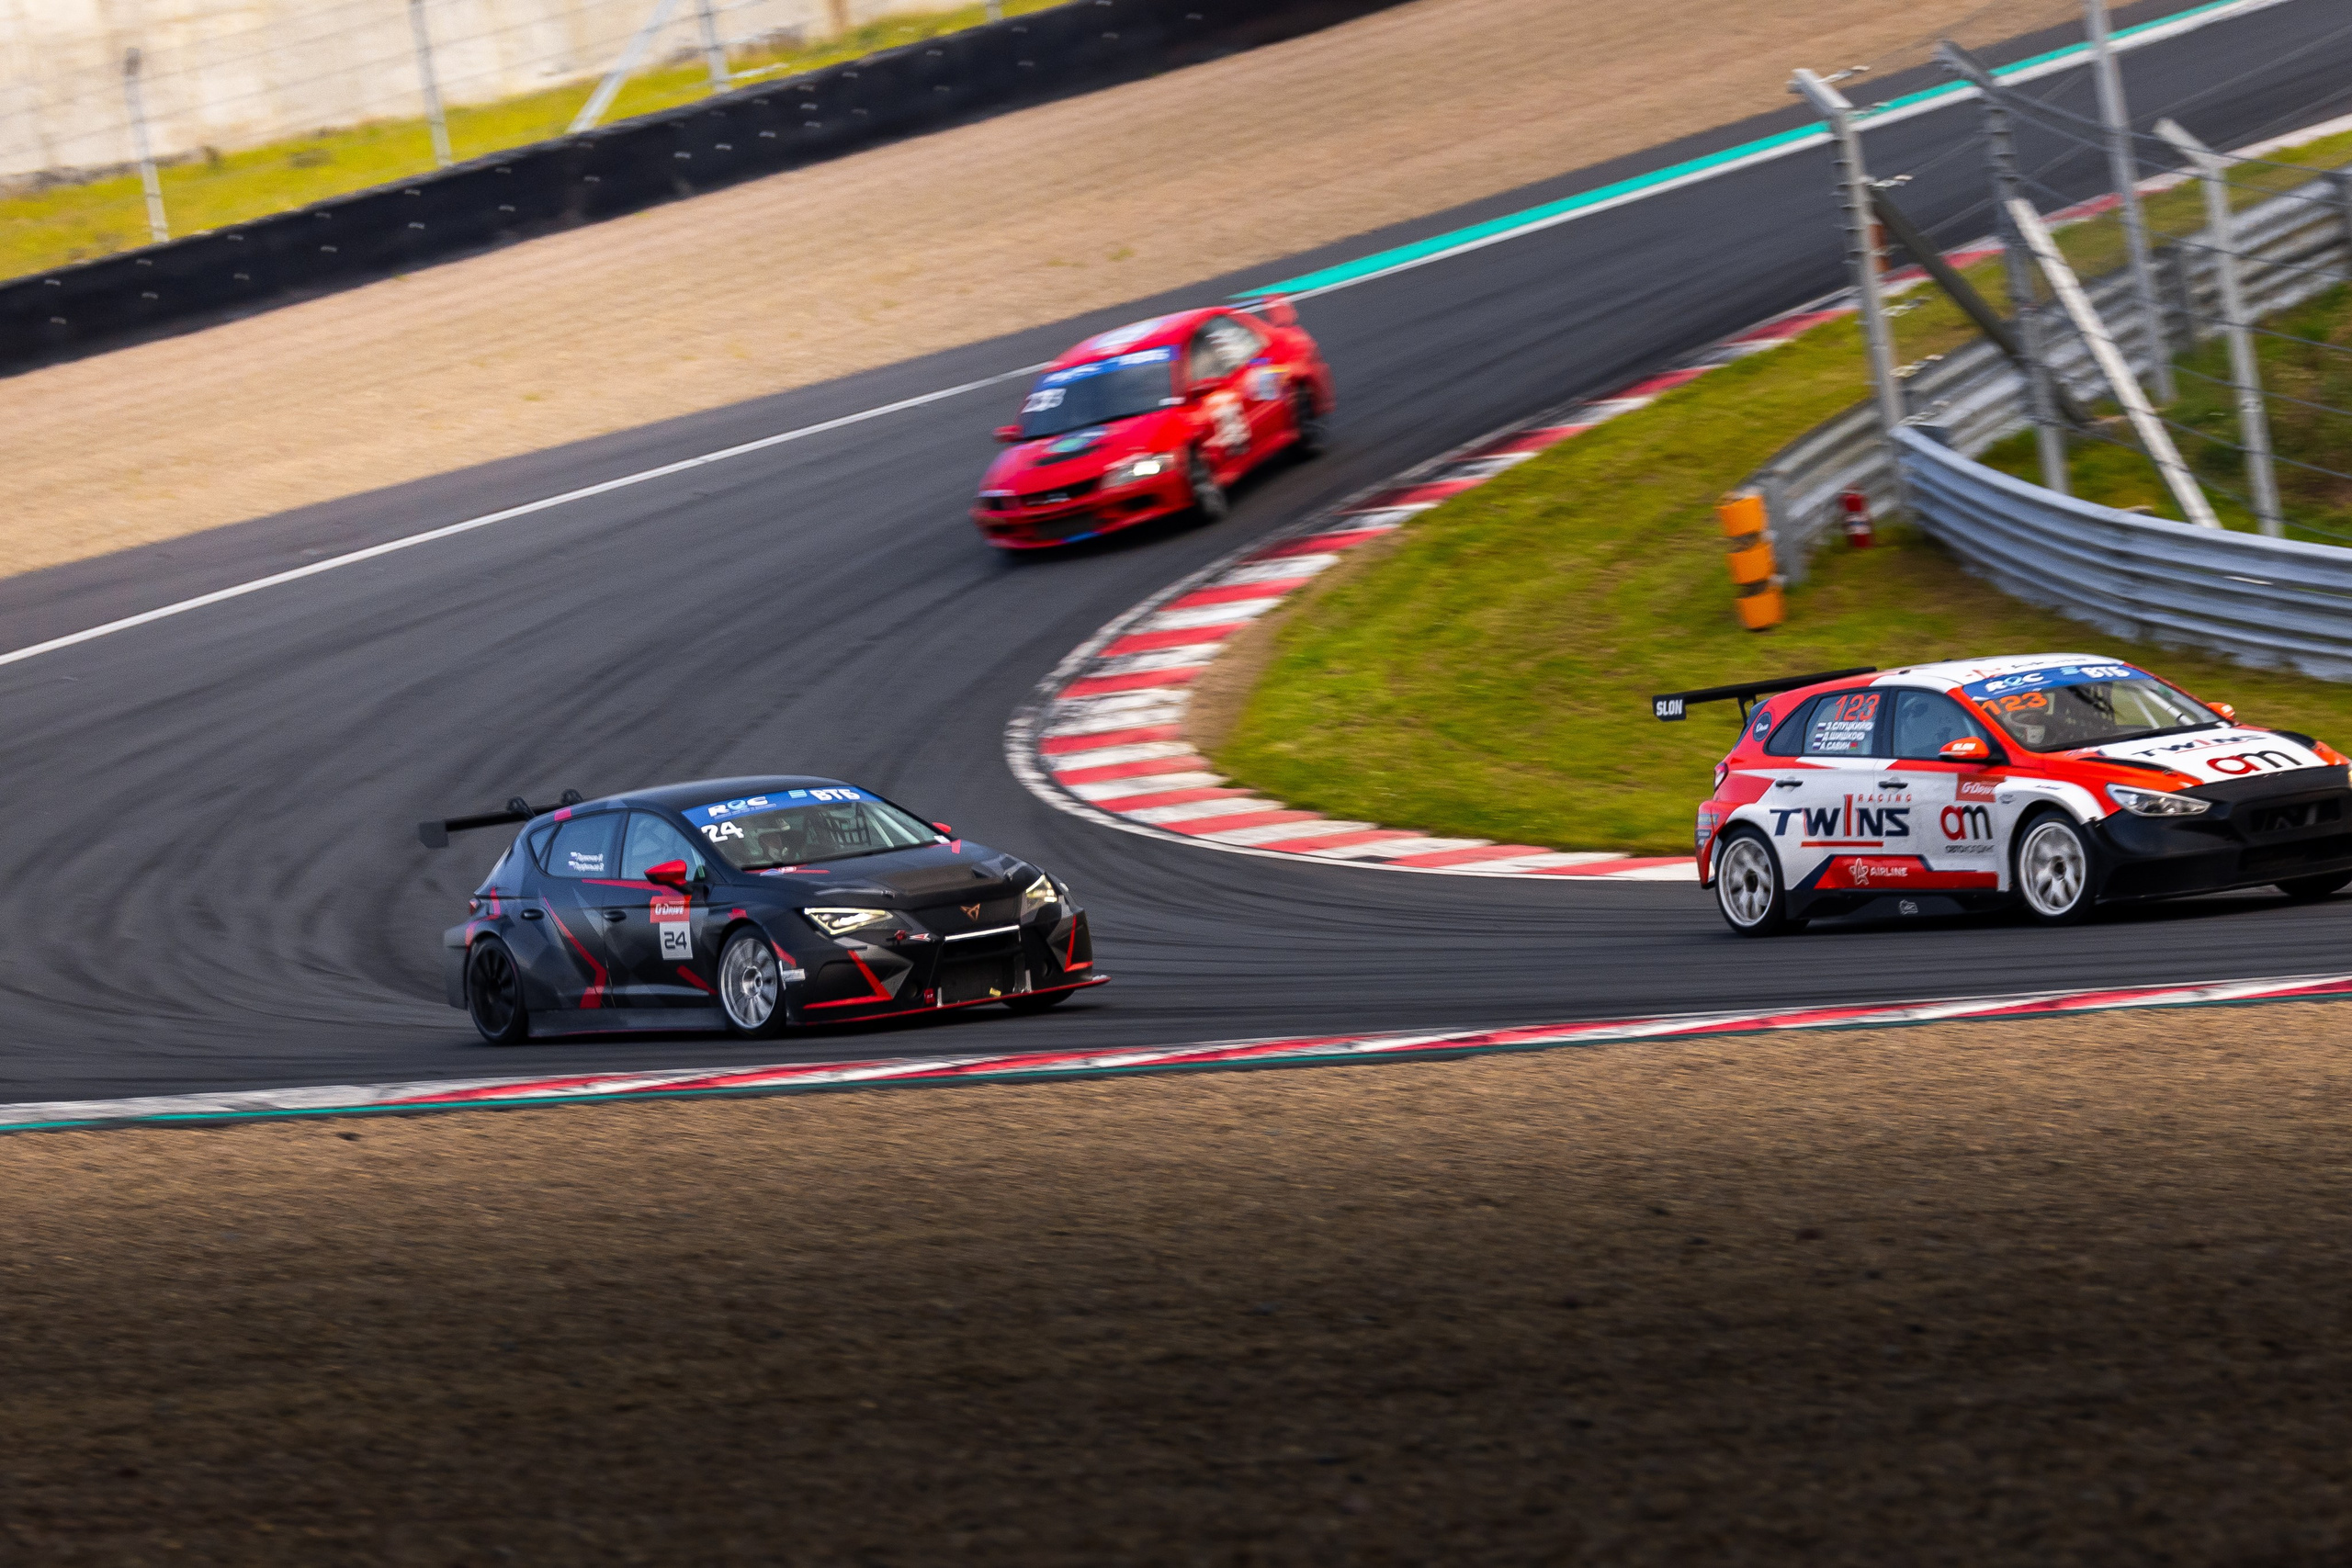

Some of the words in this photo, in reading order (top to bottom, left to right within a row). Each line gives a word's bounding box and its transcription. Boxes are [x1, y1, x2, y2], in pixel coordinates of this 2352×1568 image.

[2080, 666, 2131, 678] ВТБ
[1656, 699, 1683, 716] SLON
[1834, 694, 1881, 721] 123
[1980, 692, 2048, 716] 123
[2132, 735, 2267, 757] TWINS
[809, 788, 861, 802] ВТБ
[1857, 794, 1912, 803] RACING
[1770, 794, 1910, 837] TWINS
[700, 821, 745, 843] 24
[1870, 866, 1908, 876] AIRLINE
[663, 931, 687, 950] 24
